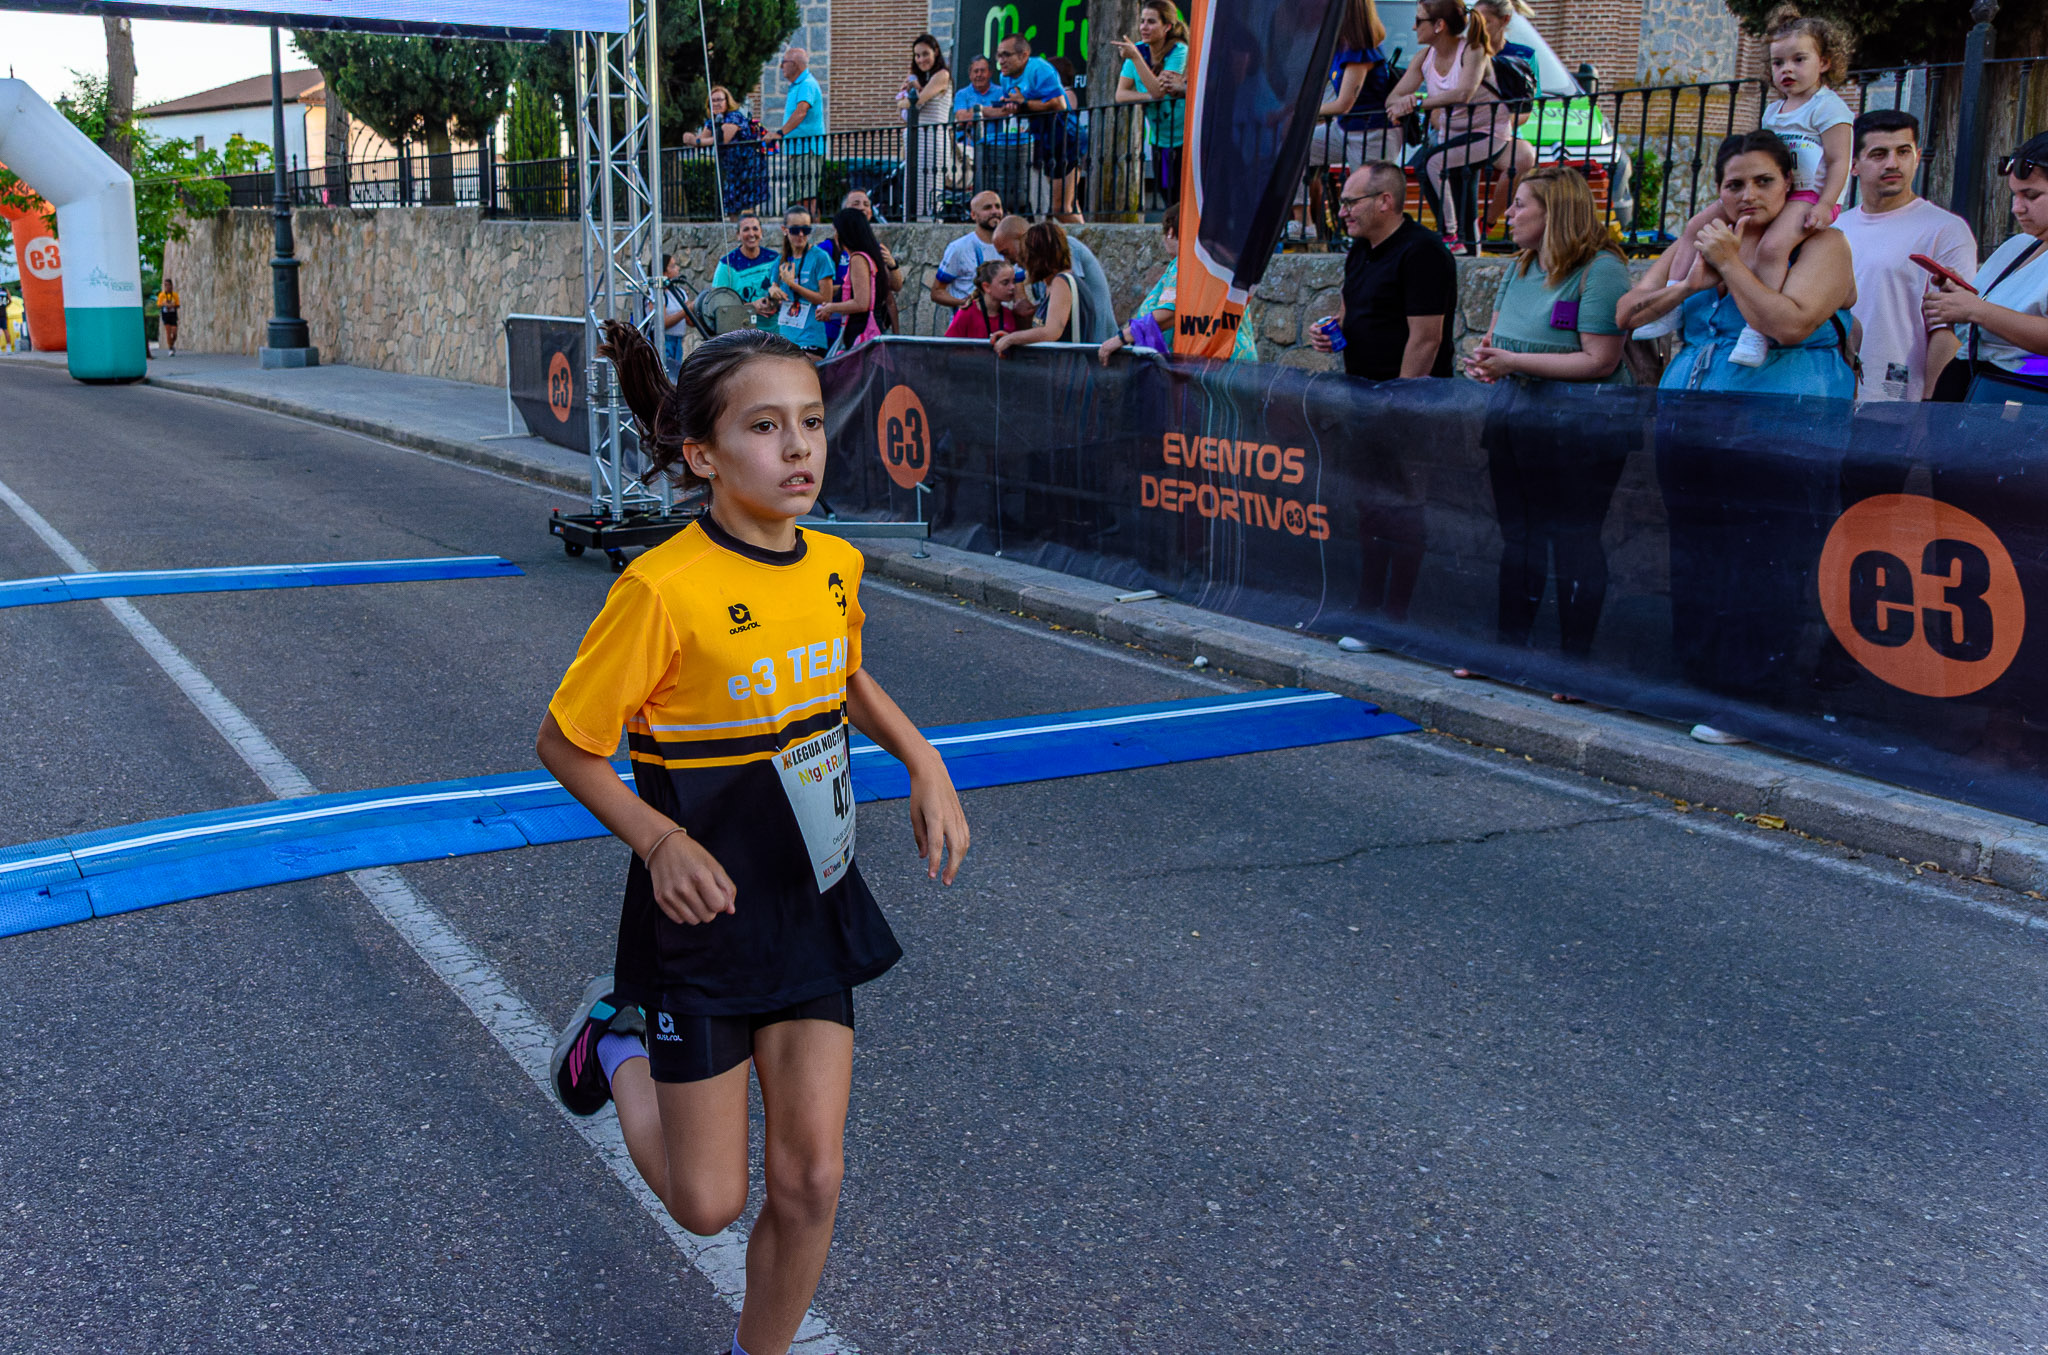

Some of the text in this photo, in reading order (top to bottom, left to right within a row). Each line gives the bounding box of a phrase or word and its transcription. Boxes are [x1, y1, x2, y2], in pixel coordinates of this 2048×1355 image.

[29, 245, 62, 271] e3
[552, 367, 569, 409] e3
[887, 408, 925, 469] e3
[1163, 432, 1305, 484] EVENTOS
[1141, 474, 1331, 541] DEPORTIVOS
[1849, 538, 1994, 663] e3
[728, 657, 777, 701] e3
[791, 740, 822, 766] LEGUA
